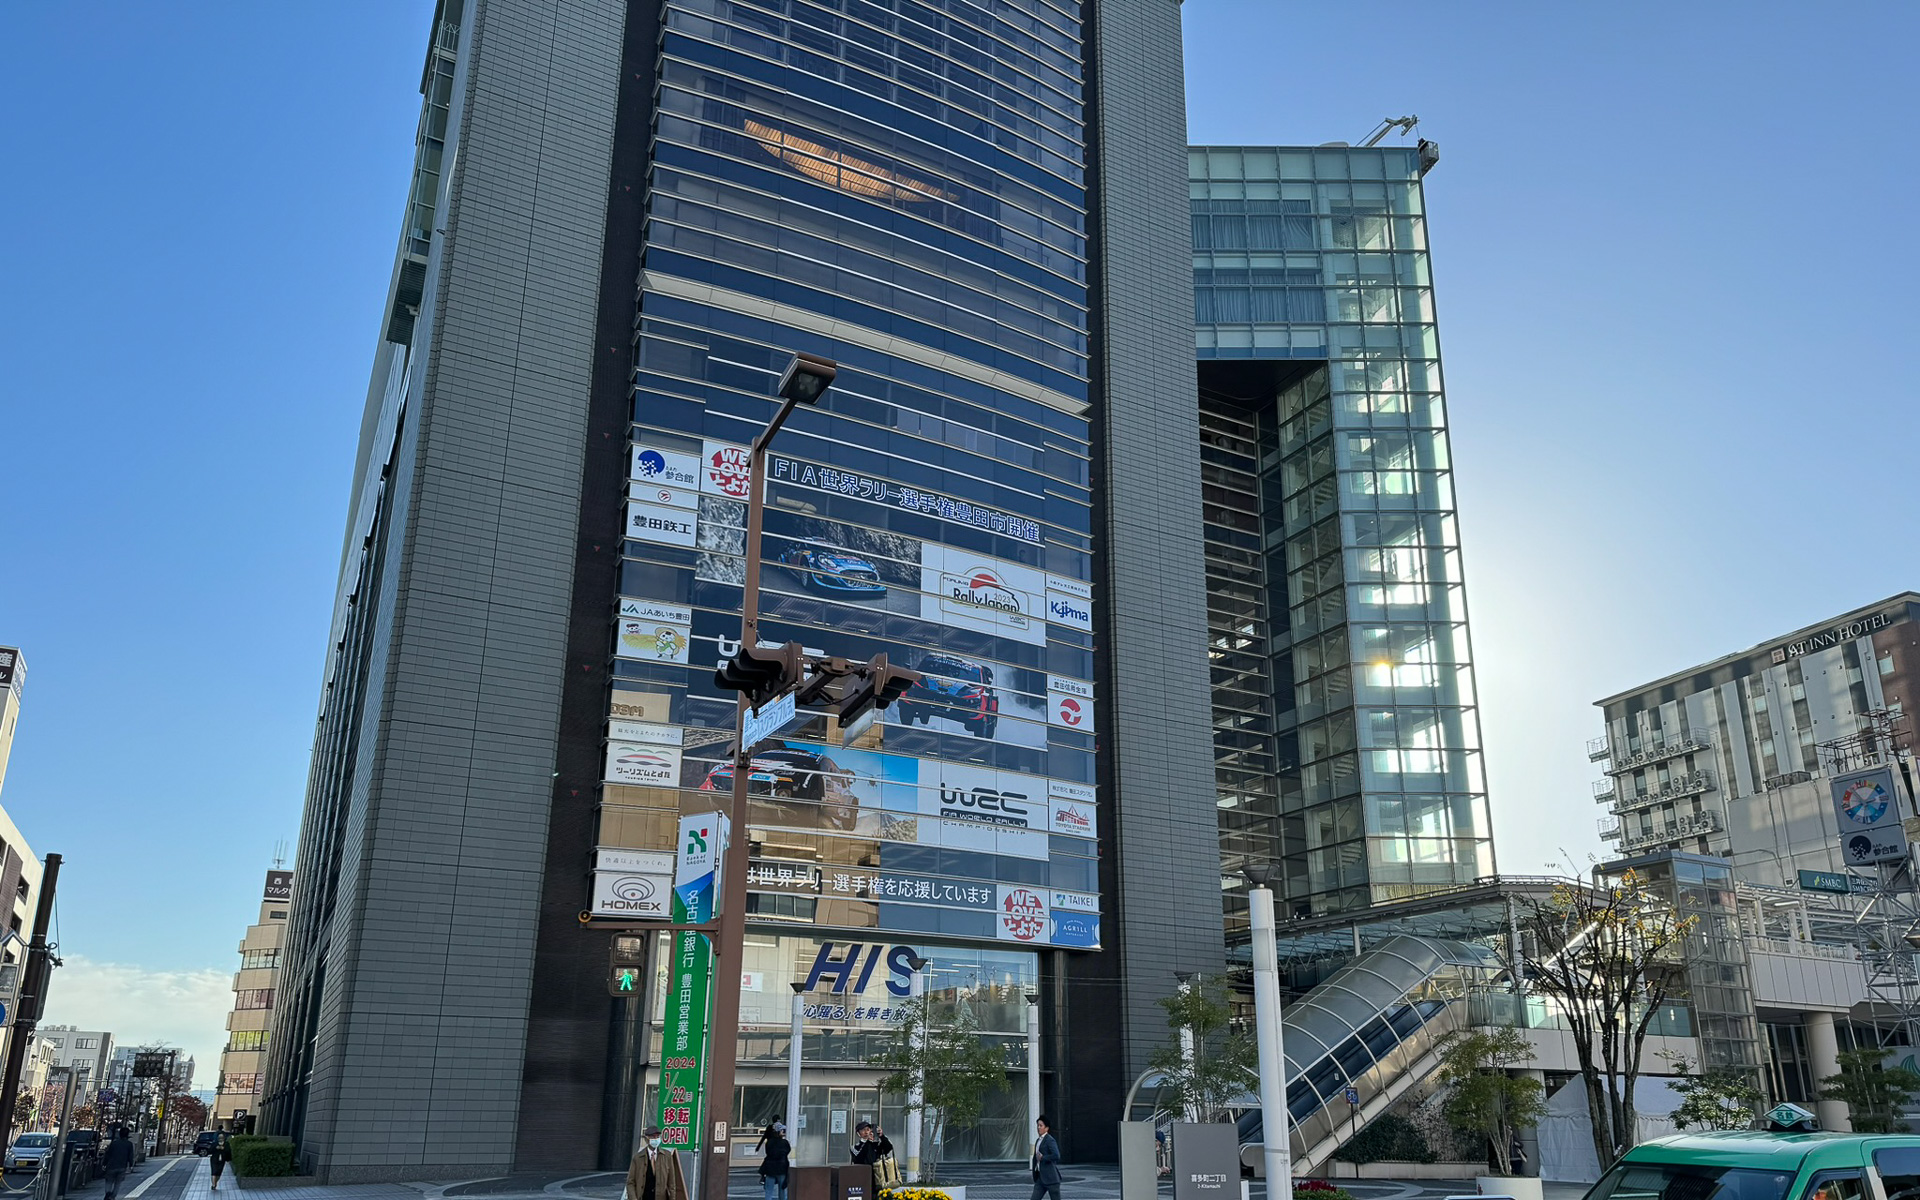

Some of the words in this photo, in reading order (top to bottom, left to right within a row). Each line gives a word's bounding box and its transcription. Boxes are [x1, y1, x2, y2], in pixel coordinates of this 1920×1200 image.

[720, 448, 751, 466] WE
[711, 461, 750, 480] LOV
[774, 458, 1040, 543] FIA世界ラリー選手権豊田市開催
[633, 514, 692, 535] 豊田鉄工
[994, 592, 1012, 604] 2023
[1810, 631, 1837, 651] INN
[1838, 613, 1891, 641] HOTEL
[1821, 877, 1842, 889] SMBC
[601, 900, 662, 911] HOMEX
[1011, 890, 1036, 907] WE
[1068, 895, 1094, 907] TAIKEI
[803, 942, 918, 997] HIS
[676, 973, 693, 1052] 豊田営業部
[665, 1056, 696, 1069] 2024
[664, 1106, 690, 1125] 移転
[662, 1126, 689, 1145] OPEN
